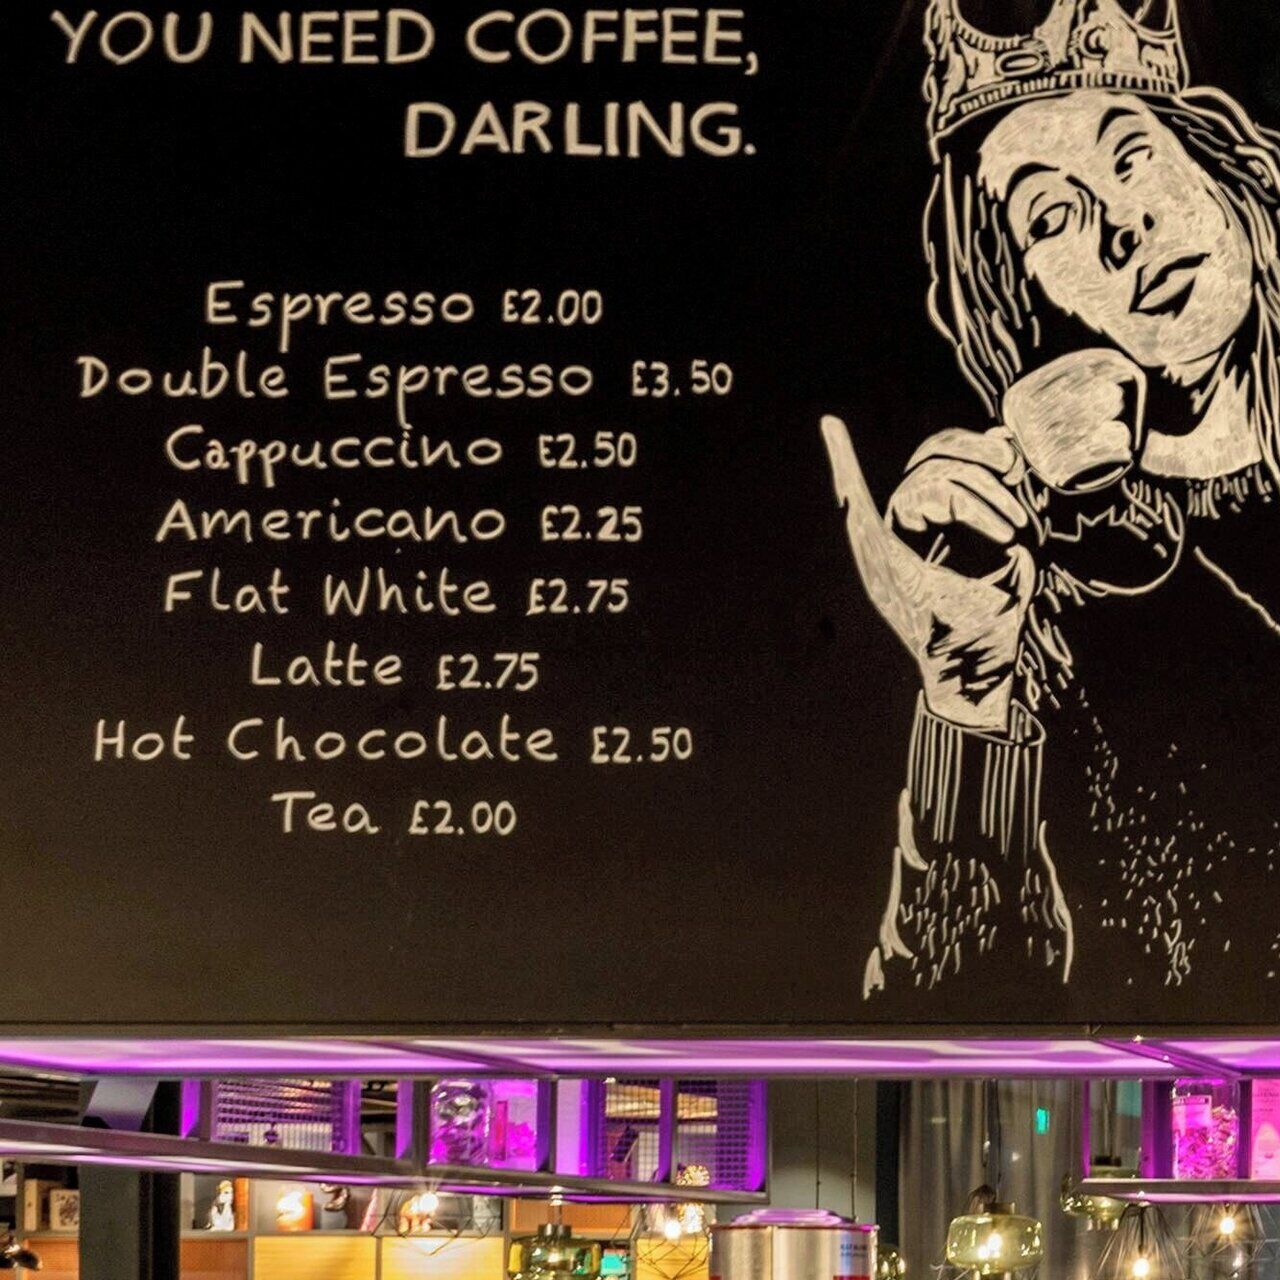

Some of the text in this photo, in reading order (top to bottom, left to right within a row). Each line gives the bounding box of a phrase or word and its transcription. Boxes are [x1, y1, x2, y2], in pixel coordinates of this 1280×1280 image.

[53, 9, 759, 76] YOU NEED COFFEE,
[406, 102, 757, 159] DARLING.
[204, 281, 603, 352] Espresso £2.00
[78, 348, 734, 429] Double Espresso £3.50
[165, 425, 638, 487] Cappuccino £2.50
[157, 499, 643, 544] Americano £2.25
[166, 567, 630, 617] Flat White £2.75
[252, 641, 541, 692] Latte £2.75
[95, 716, 694, 764] Hot Chocolate £2.50
[272, 792, 518, 836] Tea £2.00
